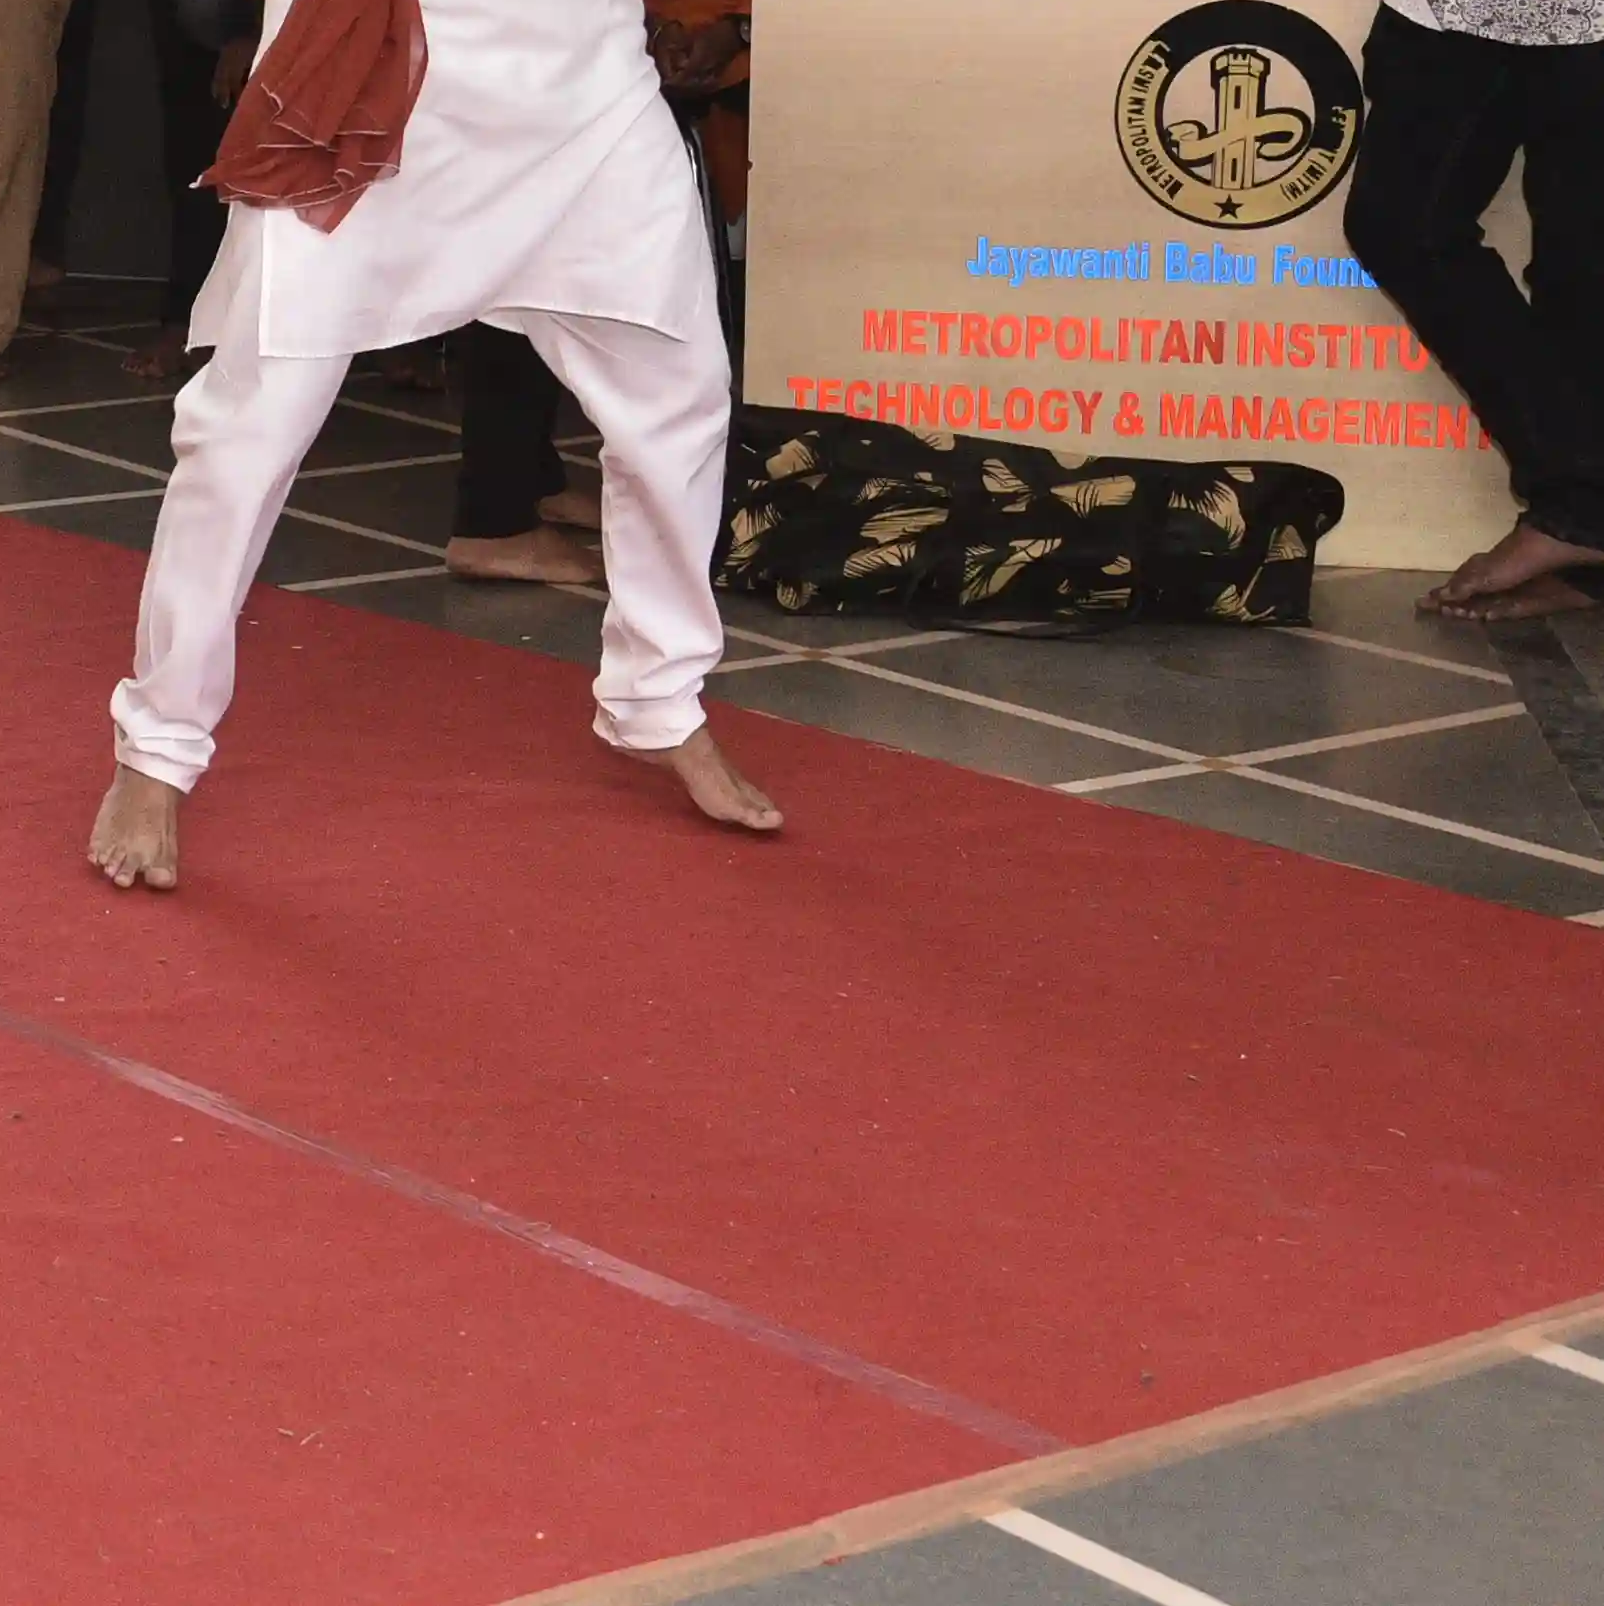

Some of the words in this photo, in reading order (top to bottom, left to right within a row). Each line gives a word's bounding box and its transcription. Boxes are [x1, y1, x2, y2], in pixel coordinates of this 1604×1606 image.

[966, 234, 1151, 288] Jayawanti
[1165, 242, 1257, 285] Babu
[862, 308, 1226, 366] METROPOLITAN
[1235, 321, 1430, 372] INSTITU
[787, 376, 1102, 434] TECHNOLOGY
[1113, 391, 1144, 437] &
